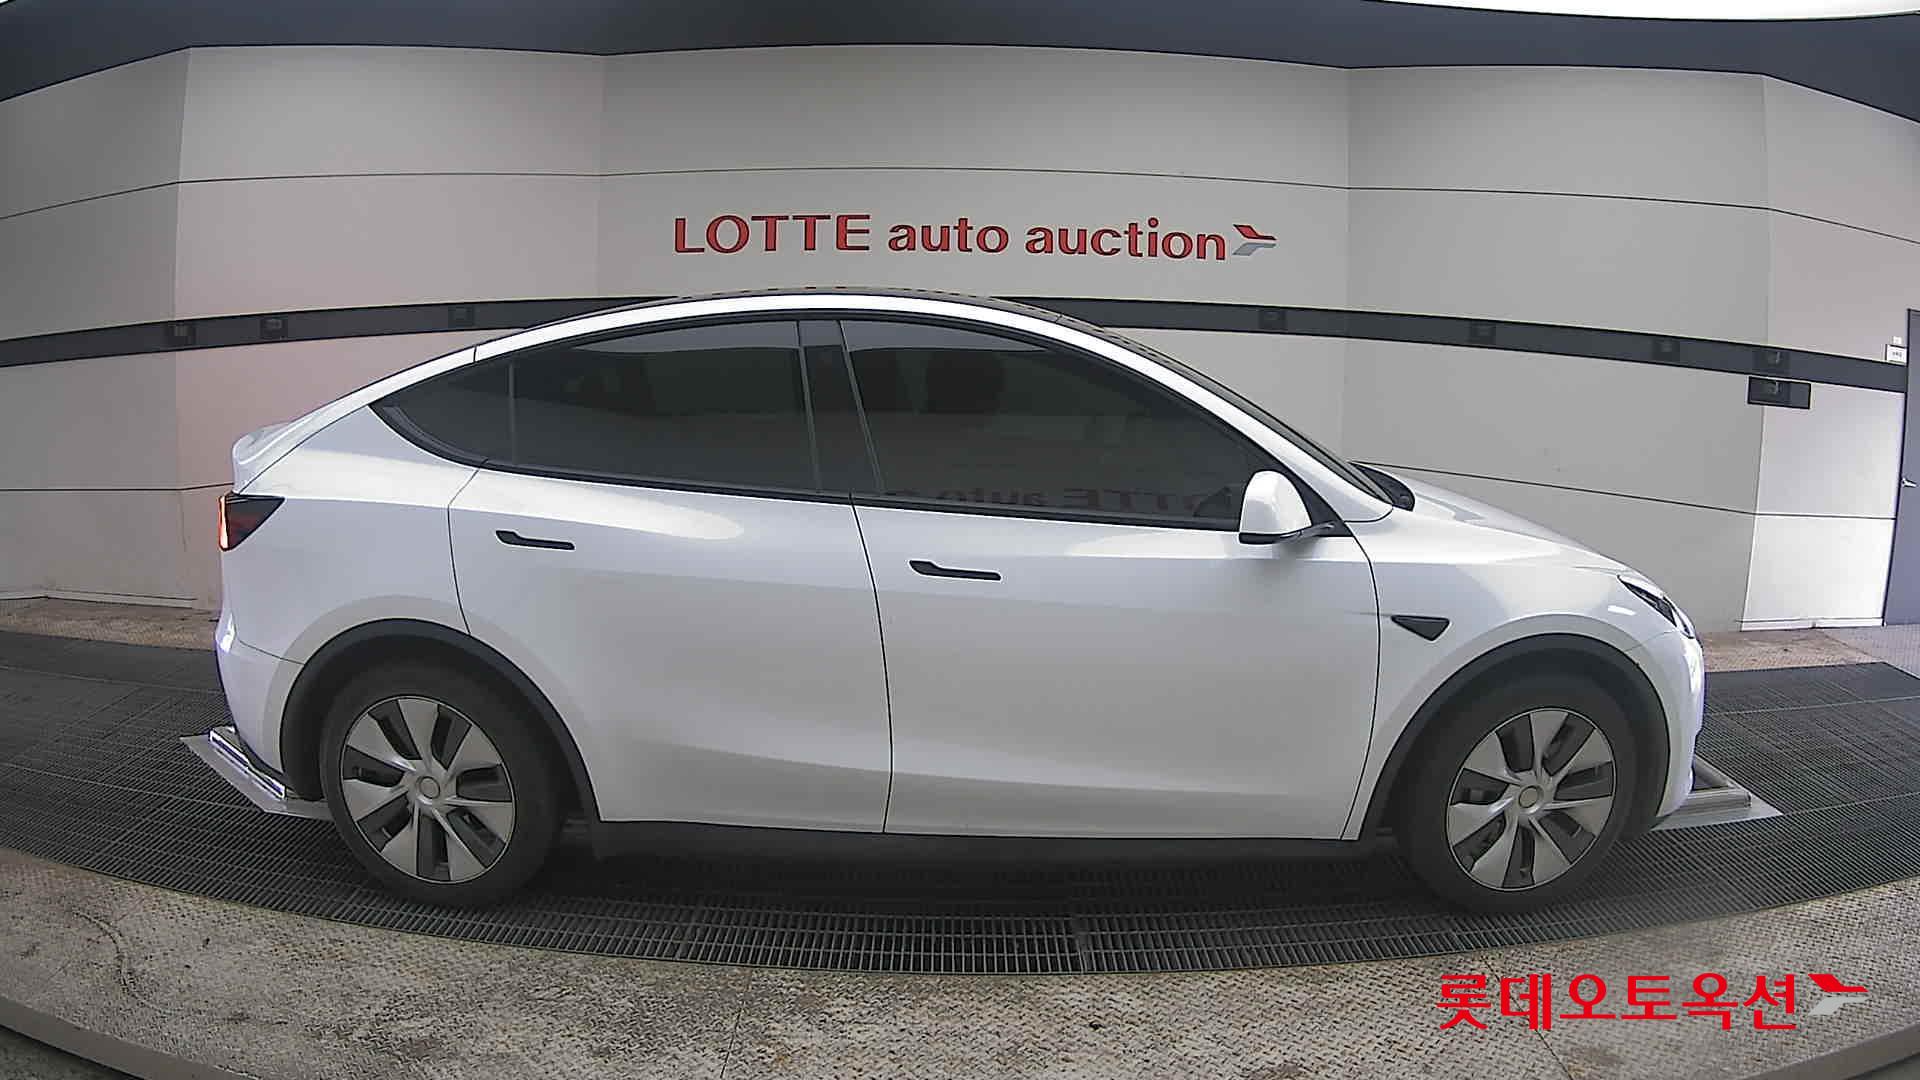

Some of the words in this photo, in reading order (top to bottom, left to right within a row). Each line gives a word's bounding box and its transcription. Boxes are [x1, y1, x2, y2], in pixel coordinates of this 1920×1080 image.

[675, 214, 870, 253] LOTTE
[887, 218, 1009, 253] auto
[1026, 218, 1227, 260] auction
